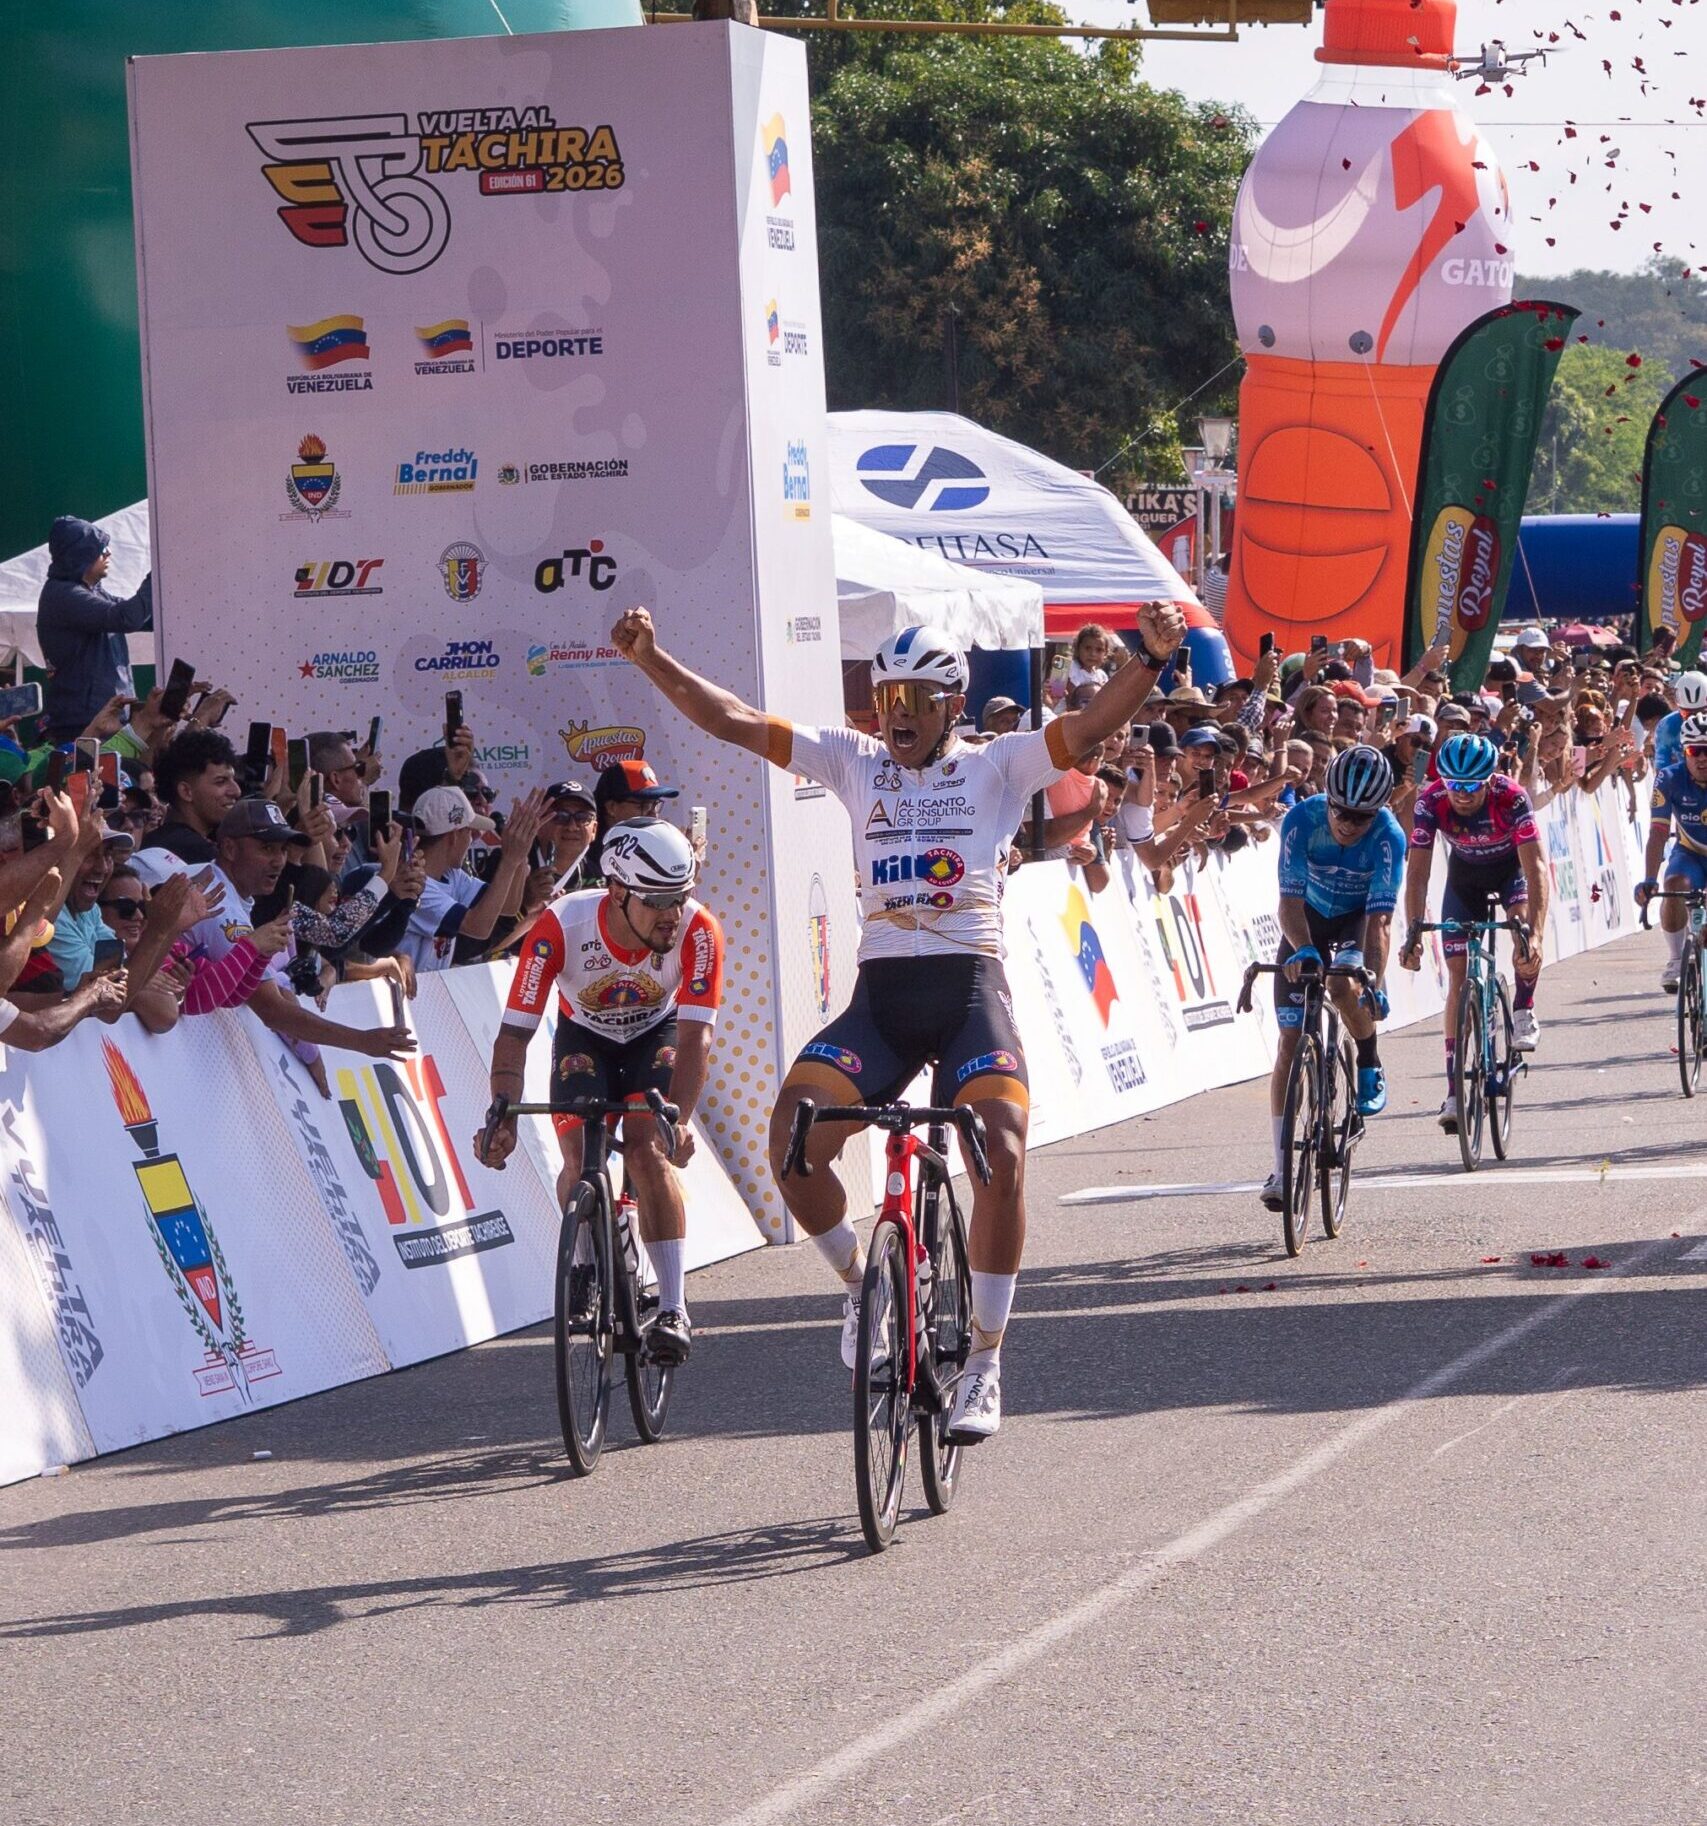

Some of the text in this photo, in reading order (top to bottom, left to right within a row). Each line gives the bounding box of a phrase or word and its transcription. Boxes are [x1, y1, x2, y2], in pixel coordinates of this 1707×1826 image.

[419, 107, 553, 134] VUELTA AL
[488, 174, 536, 190] EDICIÓN 61
[546, 165, 622, 190] 2026
[495, 336, 604, 360] DEPORTE
[414, 364, 475, 375] VENEZUELA
[287, 378, 373, 394] VENEZUELA
[415, 449, 475, 465] Freddy
[400, 459, 478, 483] Bernal
[529, 458, 628, 474] GOBERNACIÓN
[550, 472, 587, 480] ESTADO
[307, 491, 323, 500] IND
[1434, 520, 1464, 634] puestas
[1458, 528, 1493, 617] Royal
[1659, 535, 1680, 628] puestas
[444, 640, 493, 656] JHON
[549, 650, 593, 661] Renny
[312, 651, 376, 665] ARNALDO
[415, 654, 500, 672] CARRILLO
[315, 663, 380, 678] SANCHEZ
[442, 669, 497, 681] ALCALDE
[576, 730, 640, 758] Apuestas
[472, 745, 529, 762] AKISH
[494, 761, 529, 770] LICORES
[614, 833, 639, 860] 82
[692, 926, 709, 980] TACHIRA
[522, 955, 547, 1006] TACHIRA
[1, 1106, 105, 1370] VUELTA
